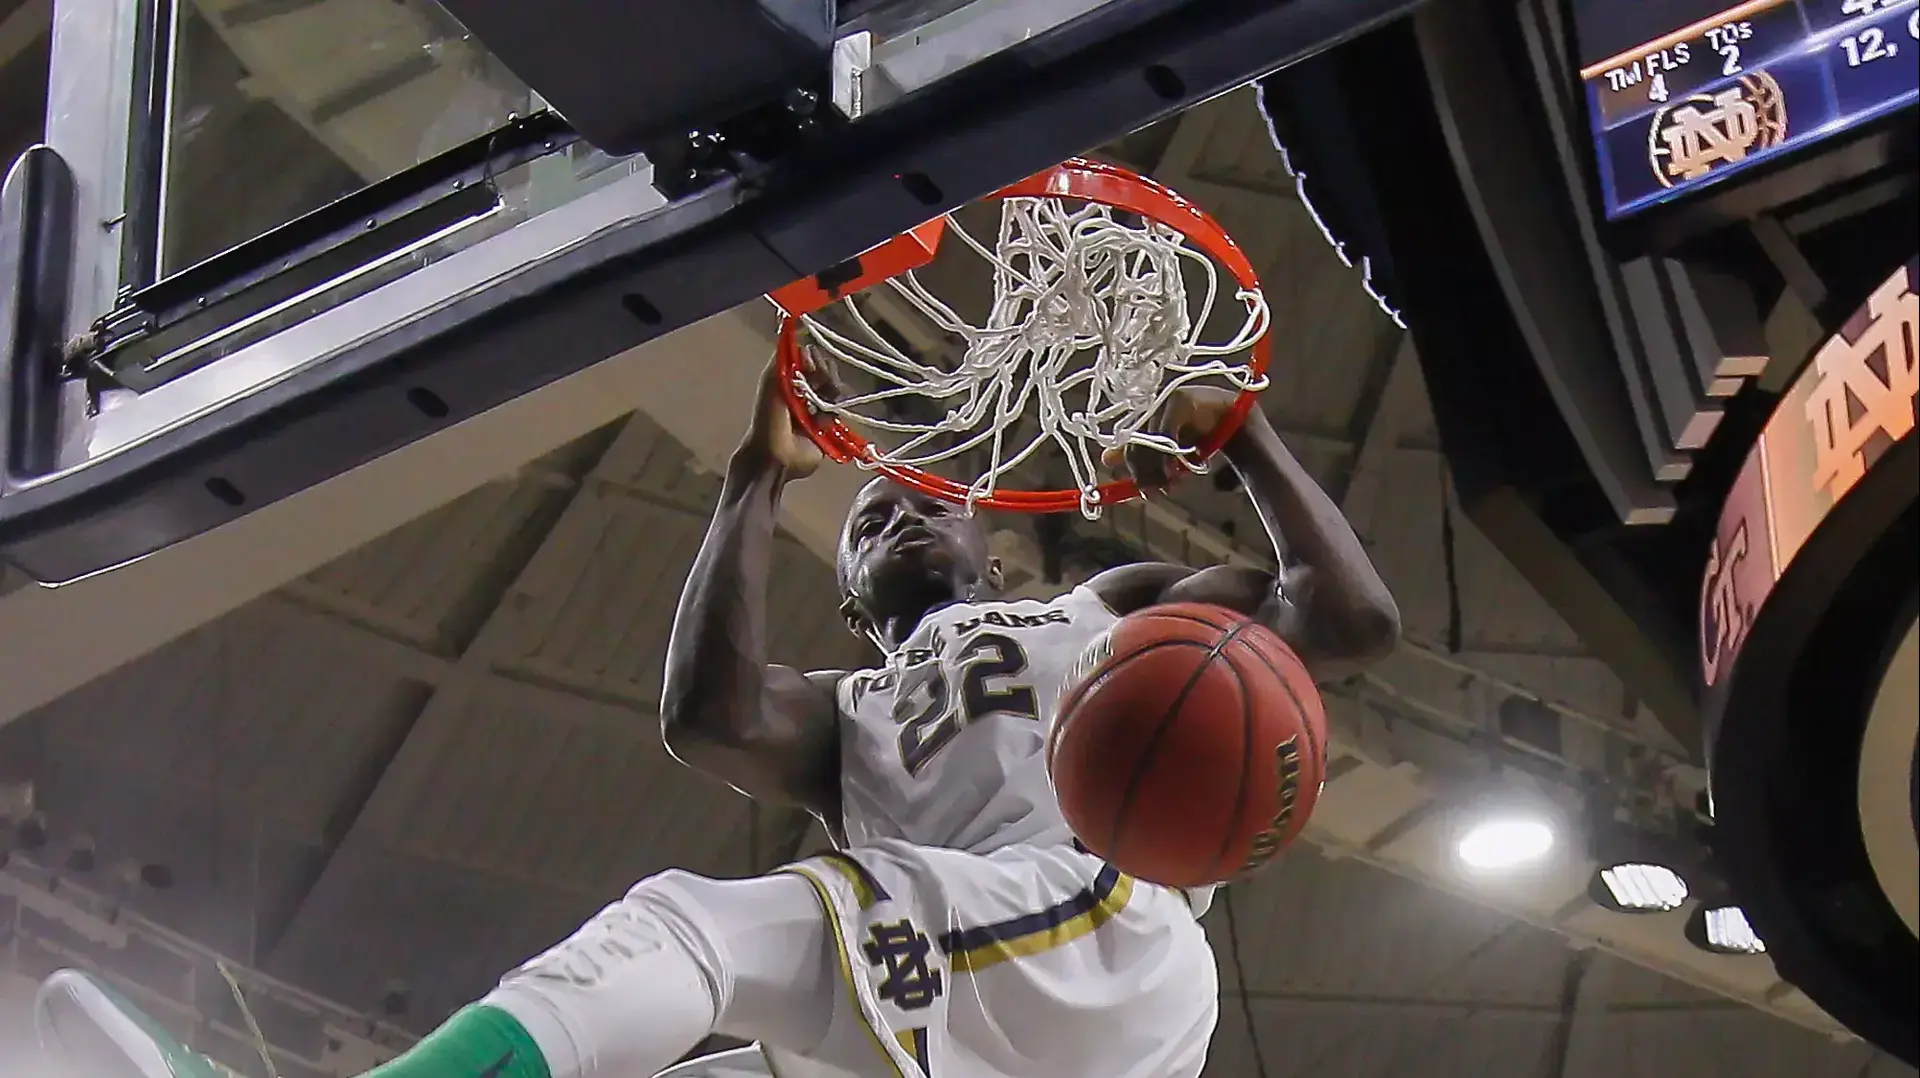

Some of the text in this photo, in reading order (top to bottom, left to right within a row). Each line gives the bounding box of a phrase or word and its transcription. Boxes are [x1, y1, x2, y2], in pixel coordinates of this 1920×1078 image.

[1603, 41, 1691, 92] TM FLS
[1718, 44, 1743, 76] 2
[1648, 73, 1670, 102] 4
[890, 630, 1041, 778] 22
